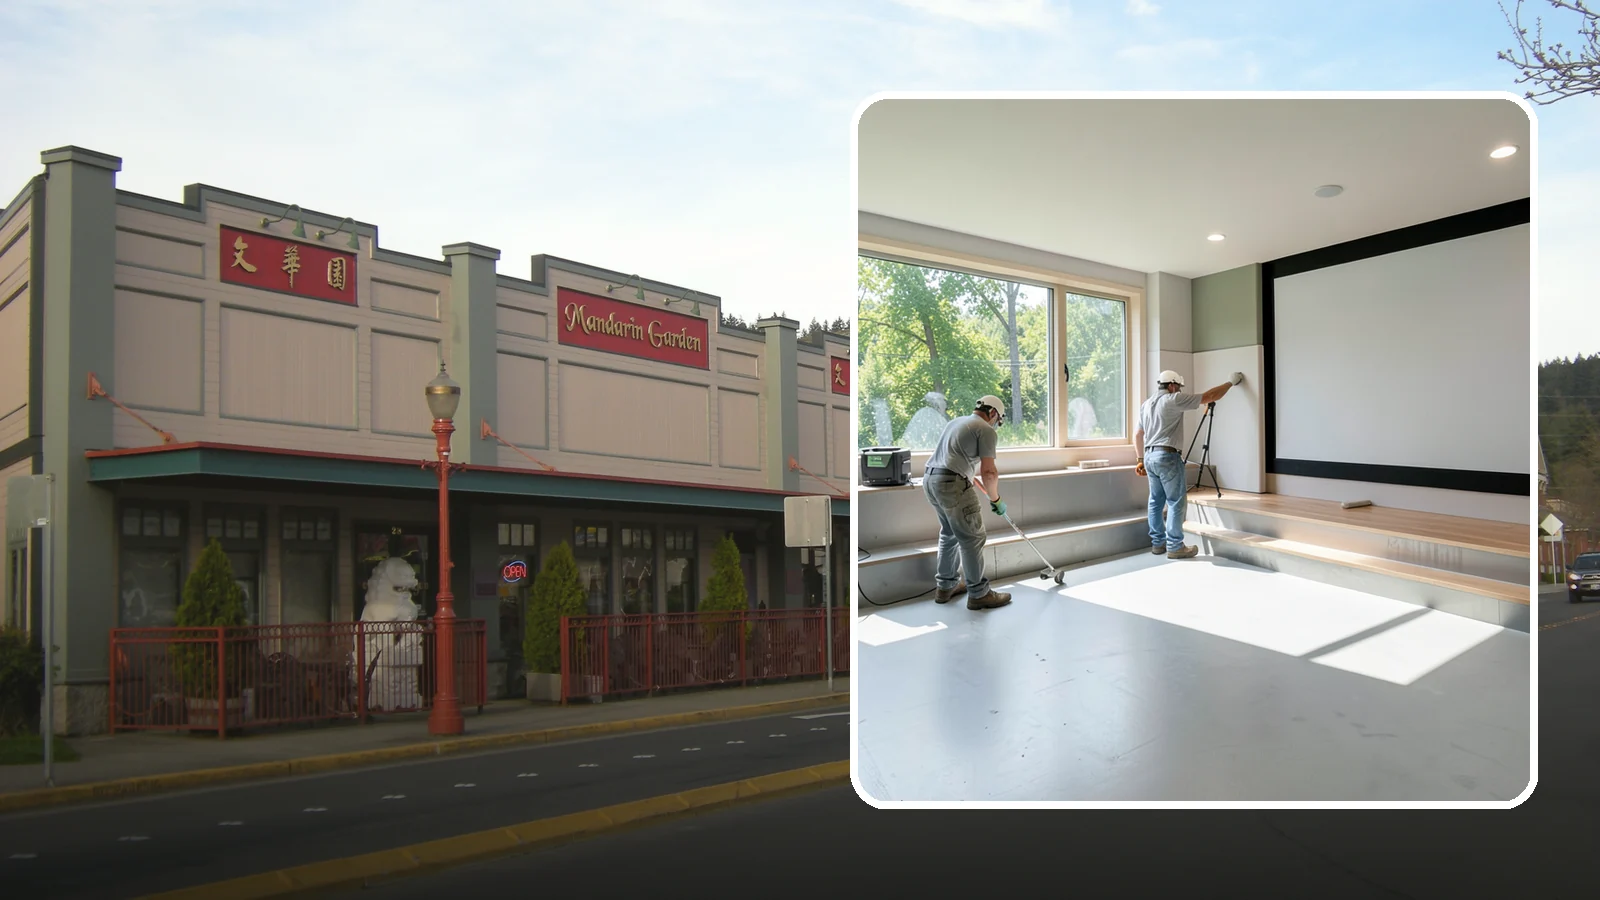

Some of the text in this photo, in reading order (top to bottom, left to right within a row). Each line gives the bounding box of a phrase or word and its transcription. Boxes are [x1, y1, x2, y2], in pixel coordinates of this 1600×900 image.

[564, 302, 701, 352] Mandarin Garden
[503, 565, 527, 578] OPEN
